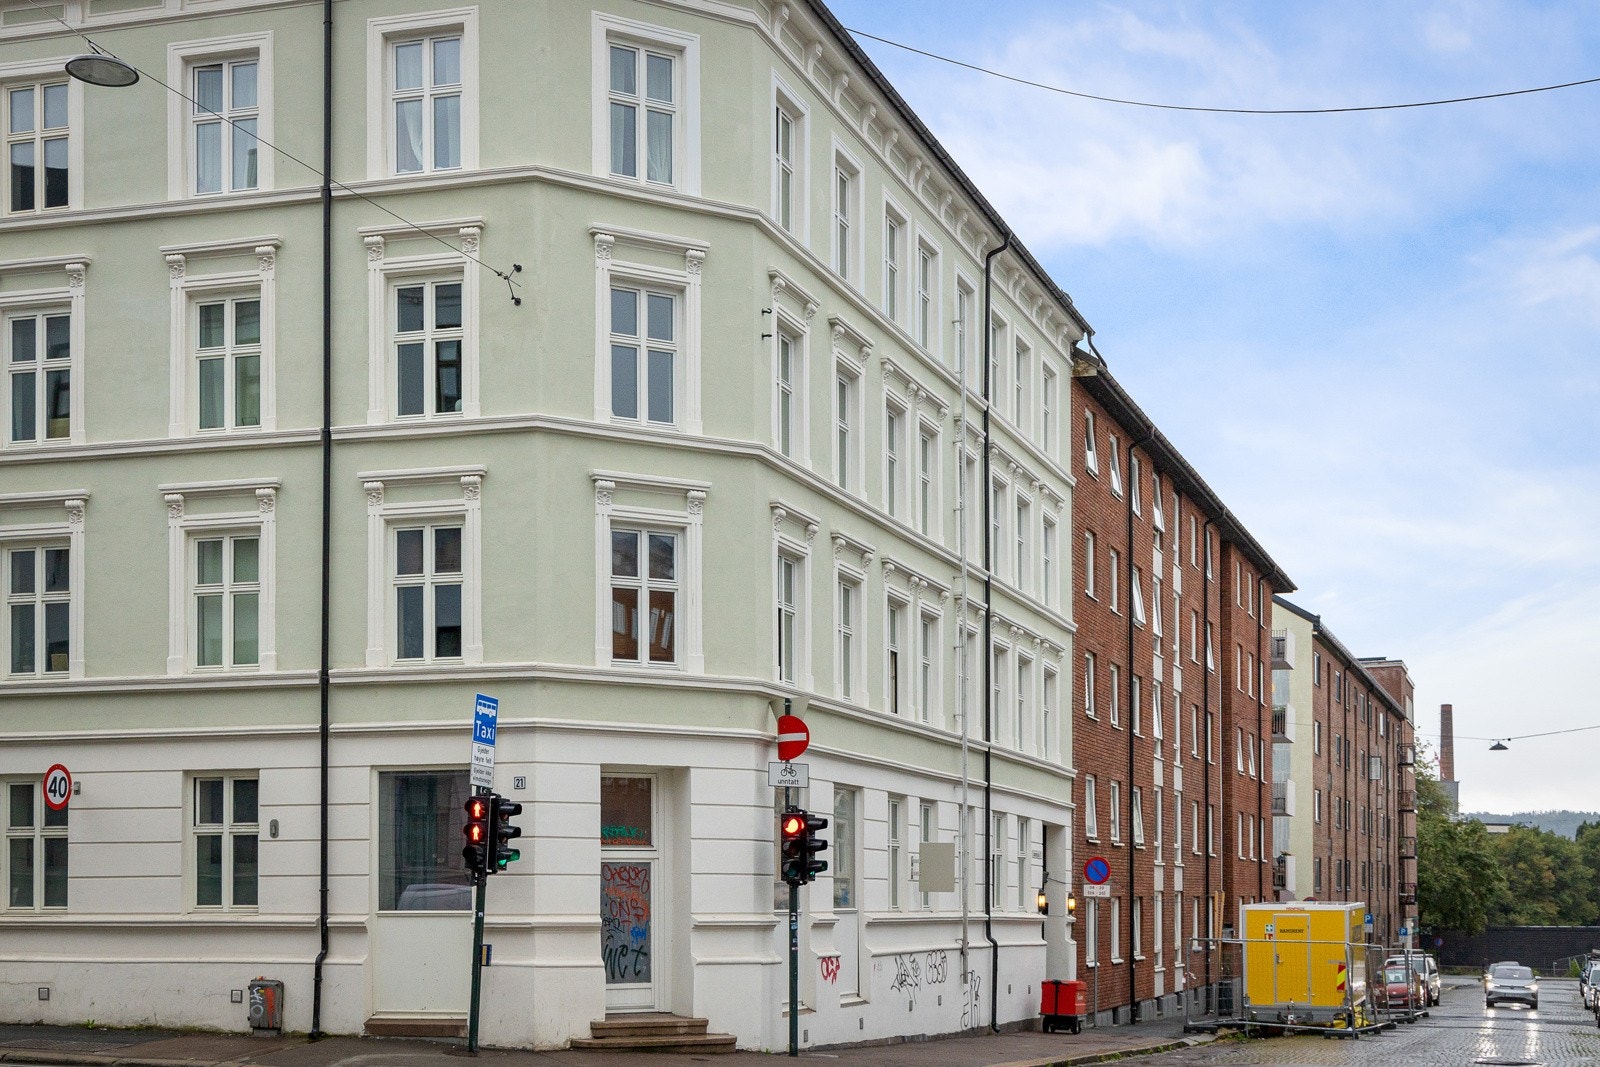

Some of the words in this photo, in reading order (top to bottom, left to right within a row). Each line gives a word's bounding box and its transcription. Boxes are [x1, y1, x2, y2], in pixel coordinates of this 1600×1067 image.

[476, 720, 495, 741] Taxi
[477, 745, 490, 754] Gjelder
[48, 776, 68, 798] 40
[515, 778, 524, 788] 21
[1365, 915, 1371, 923] P
